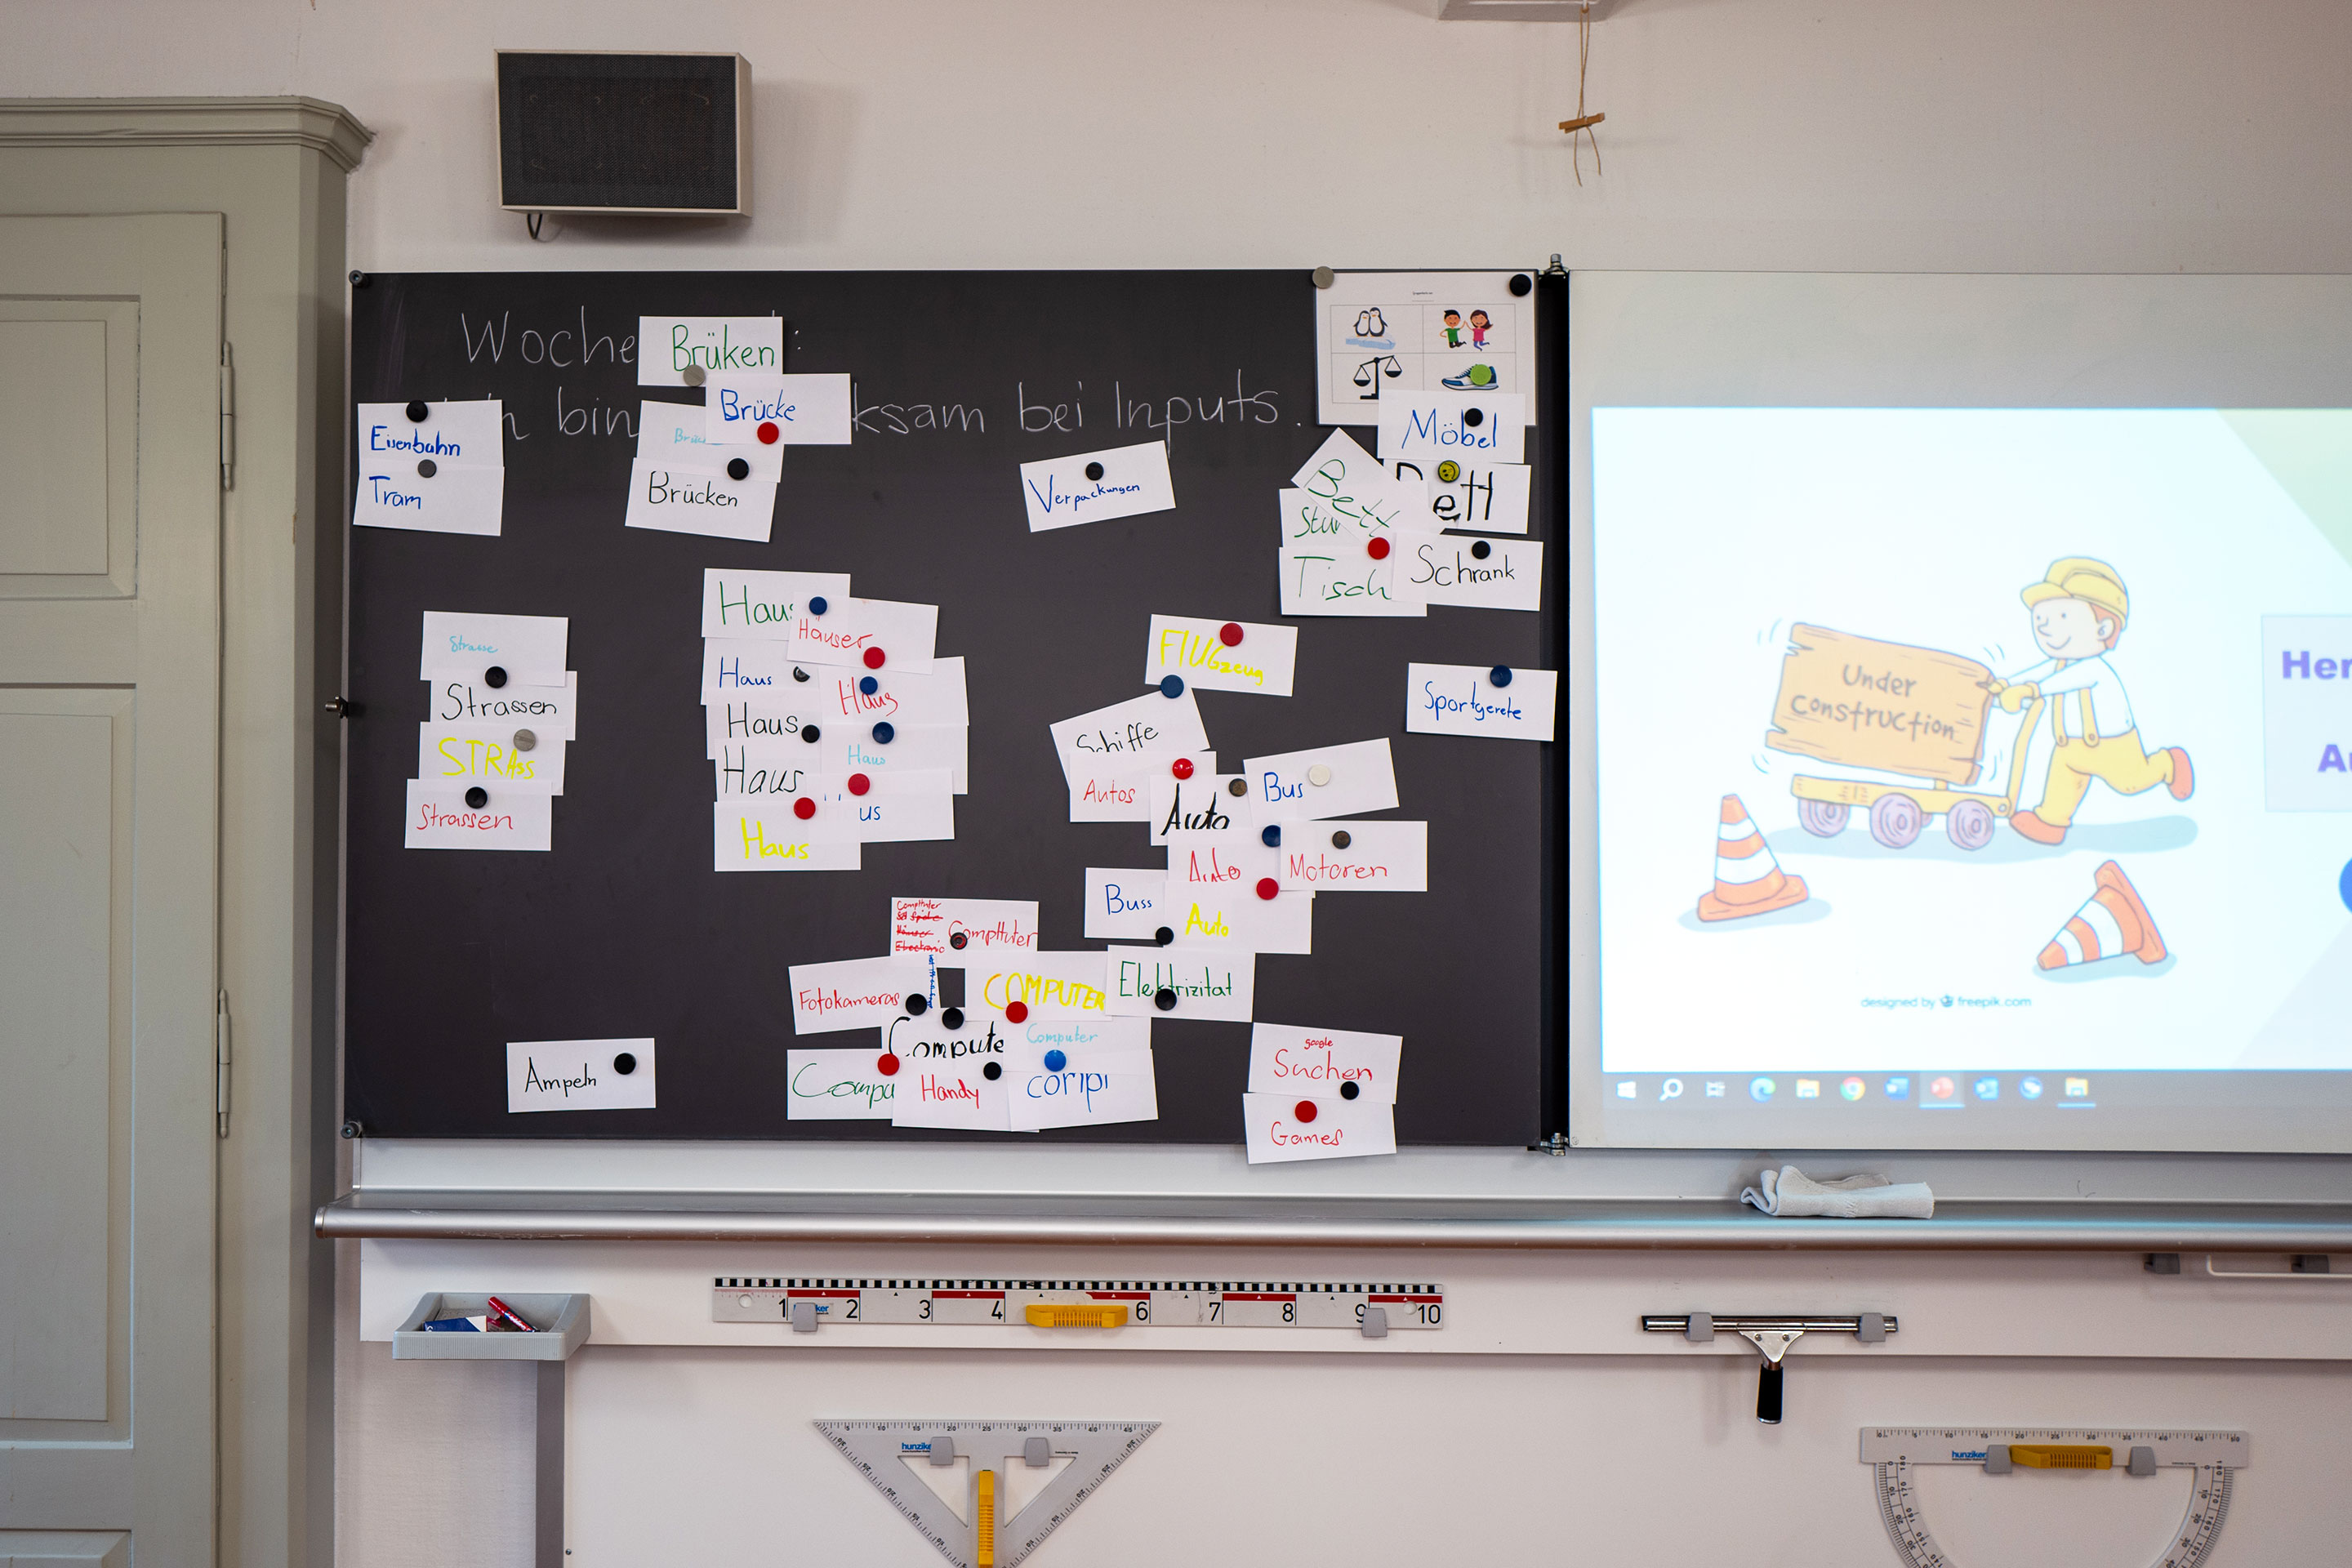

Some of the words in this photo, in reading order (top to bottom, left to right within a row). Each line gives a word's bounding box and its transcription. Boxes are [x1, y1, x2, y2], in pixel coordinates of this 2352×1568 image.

[672, 323, 775, 372] Brüken
[558, 385, 639, 437] bin
[1019, 381, 1082, 432] bei
[721, 388, 795, 421] Brücke
[370, 425, 461, 457] Eisenbahn
[1401, 408, 1497, 449] Möbel
[368, 474, 422, 510] Tram
[648, 470, 738, 509] Brücken
[1028, 474, 1141, 512] Verpackungen
[1294, 555, 1392, 600] Tisch
[1410, 545, 1516, 586] Schrank
[799, 615, 873, 648] Häuser
[719, 656, 772, 688] Haus
[1842, 663, 1917, 697] Under
[441, 683, 557, 720] Strassen
[1424, 680, 1522, 721] Sportgerete
[728, 702, 799, 738] Haus
[724, 745, 804, 794] Haus
[848, 744, 886, 765] Haus
[1083, 778, 1136, 804] Autos
[1263, 771, 1304, 802] Bus
[416, 803, 514, 831] Strassen
[1160, 782, 1231, 836] Auto
[741, 817, 809, 859] Haus
[1105, 884, 1152, 915] Buss
[1186, 902, 1229, 938] Auto
[800, 987, 900, 1015] Fotokameras
[984, 972, 1106, 1011] COMPUTER
[1860, 996, 1918, 1010] designed
[1921, 996, 1936, 1010] by
[1958, 996, 2032, 1009] freepik.com
[1027, 1022, 1098, 1049] Computer
[525, 1056, 597, 1098] Ampeln
[1274, 1048, 1373, 1081] Suchen
[921, 1074, 980, 1110] Handy
[778, 1298, 786, 1318] 1
[845, 1299, 858, 1319] 2
[918, 1299, 931, 1320] 3
[991, 1299, 1004, 1321] 4
[1135, 1301, 1149, 1321] 6
[1209, 1302, 1222, 1321] 7
[1281, 1303, 1294, 1322] 8
[1417, 1303, 1441, 1324] 10
